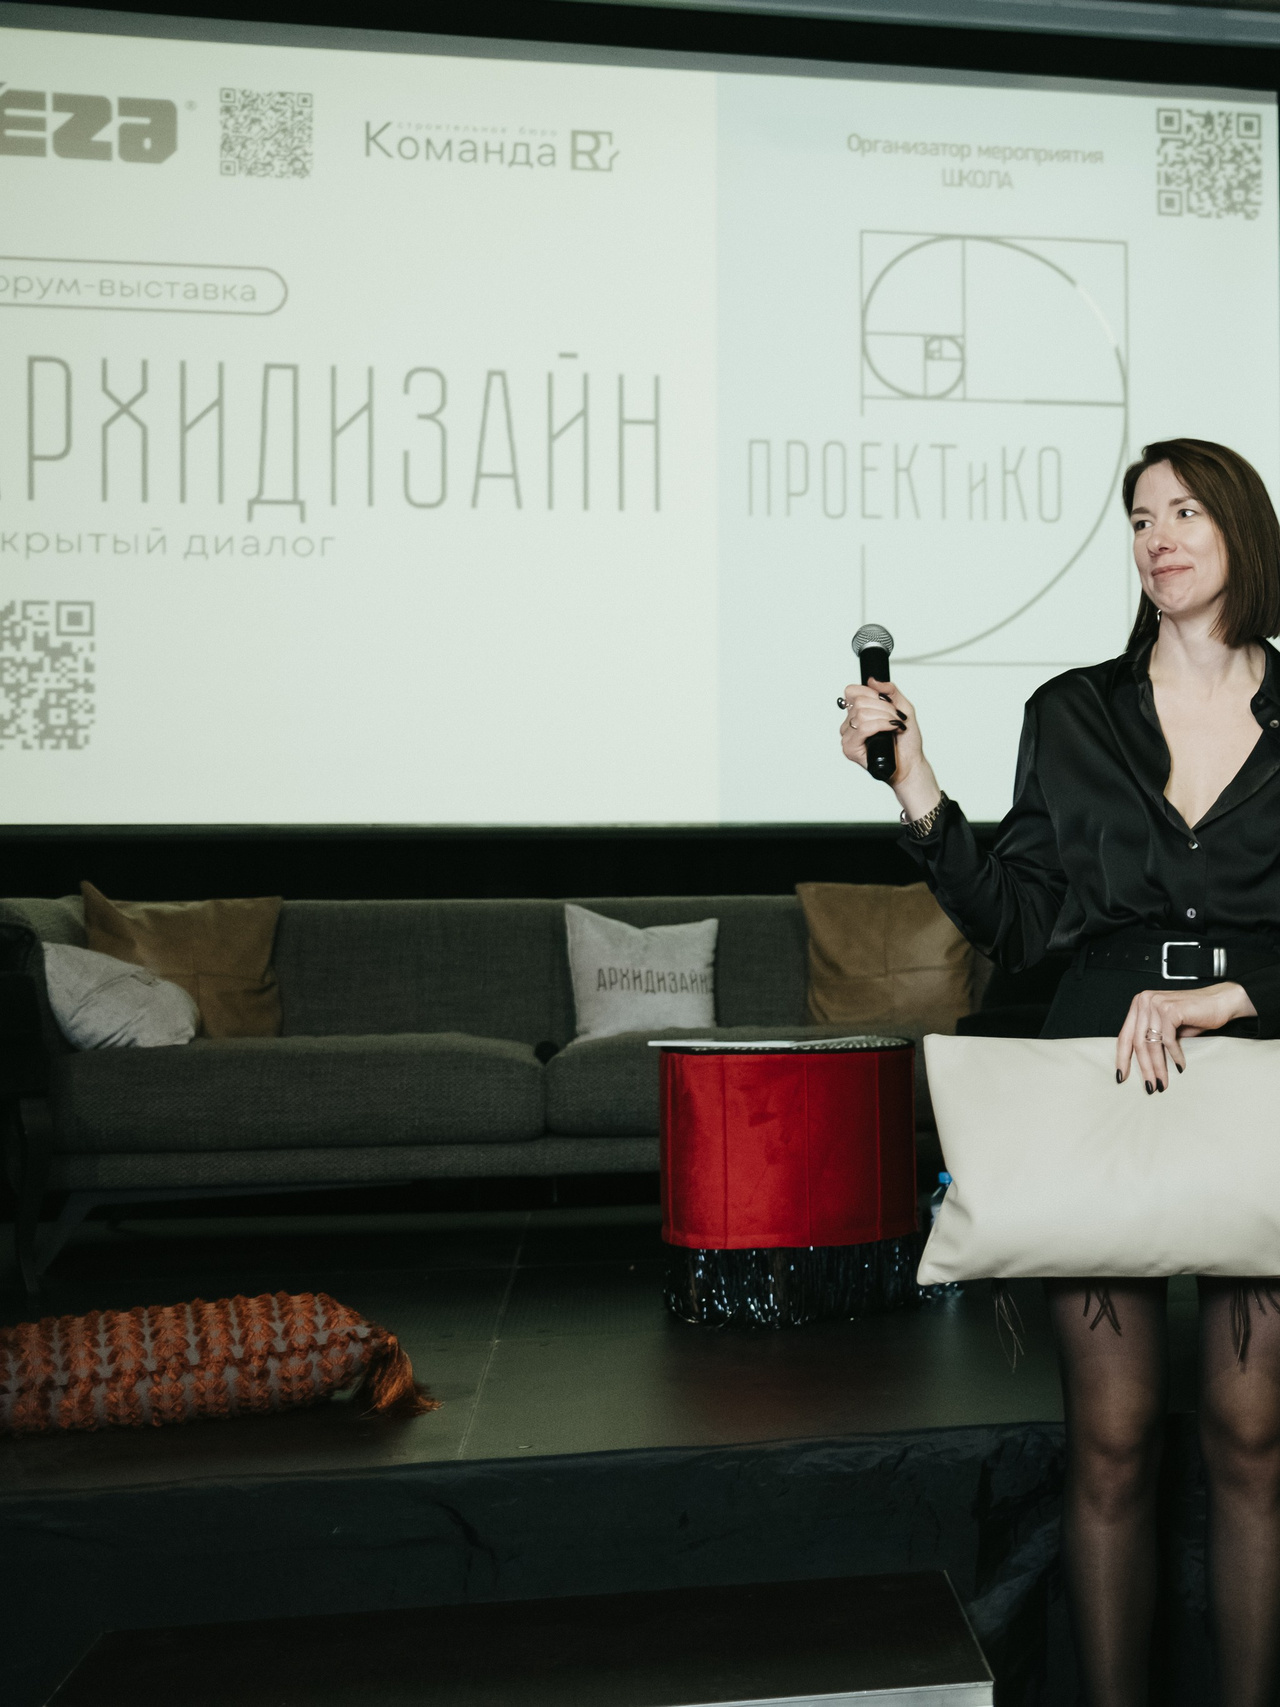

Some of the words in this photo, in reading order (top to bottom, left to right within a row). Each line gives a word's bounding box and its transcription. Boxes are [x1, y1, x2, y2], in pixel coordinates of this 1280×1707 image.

[365, 121, 557, 168] Команда
[846, 132, 972, 162] Организатор
[977, 143, 1105, 166] мероприятия
[941, 167, 1014, 190] ШКОЛА
[0, 352, 662, 523] РХИДИЗАЙН
[183, 532, 336, 560] диалог
